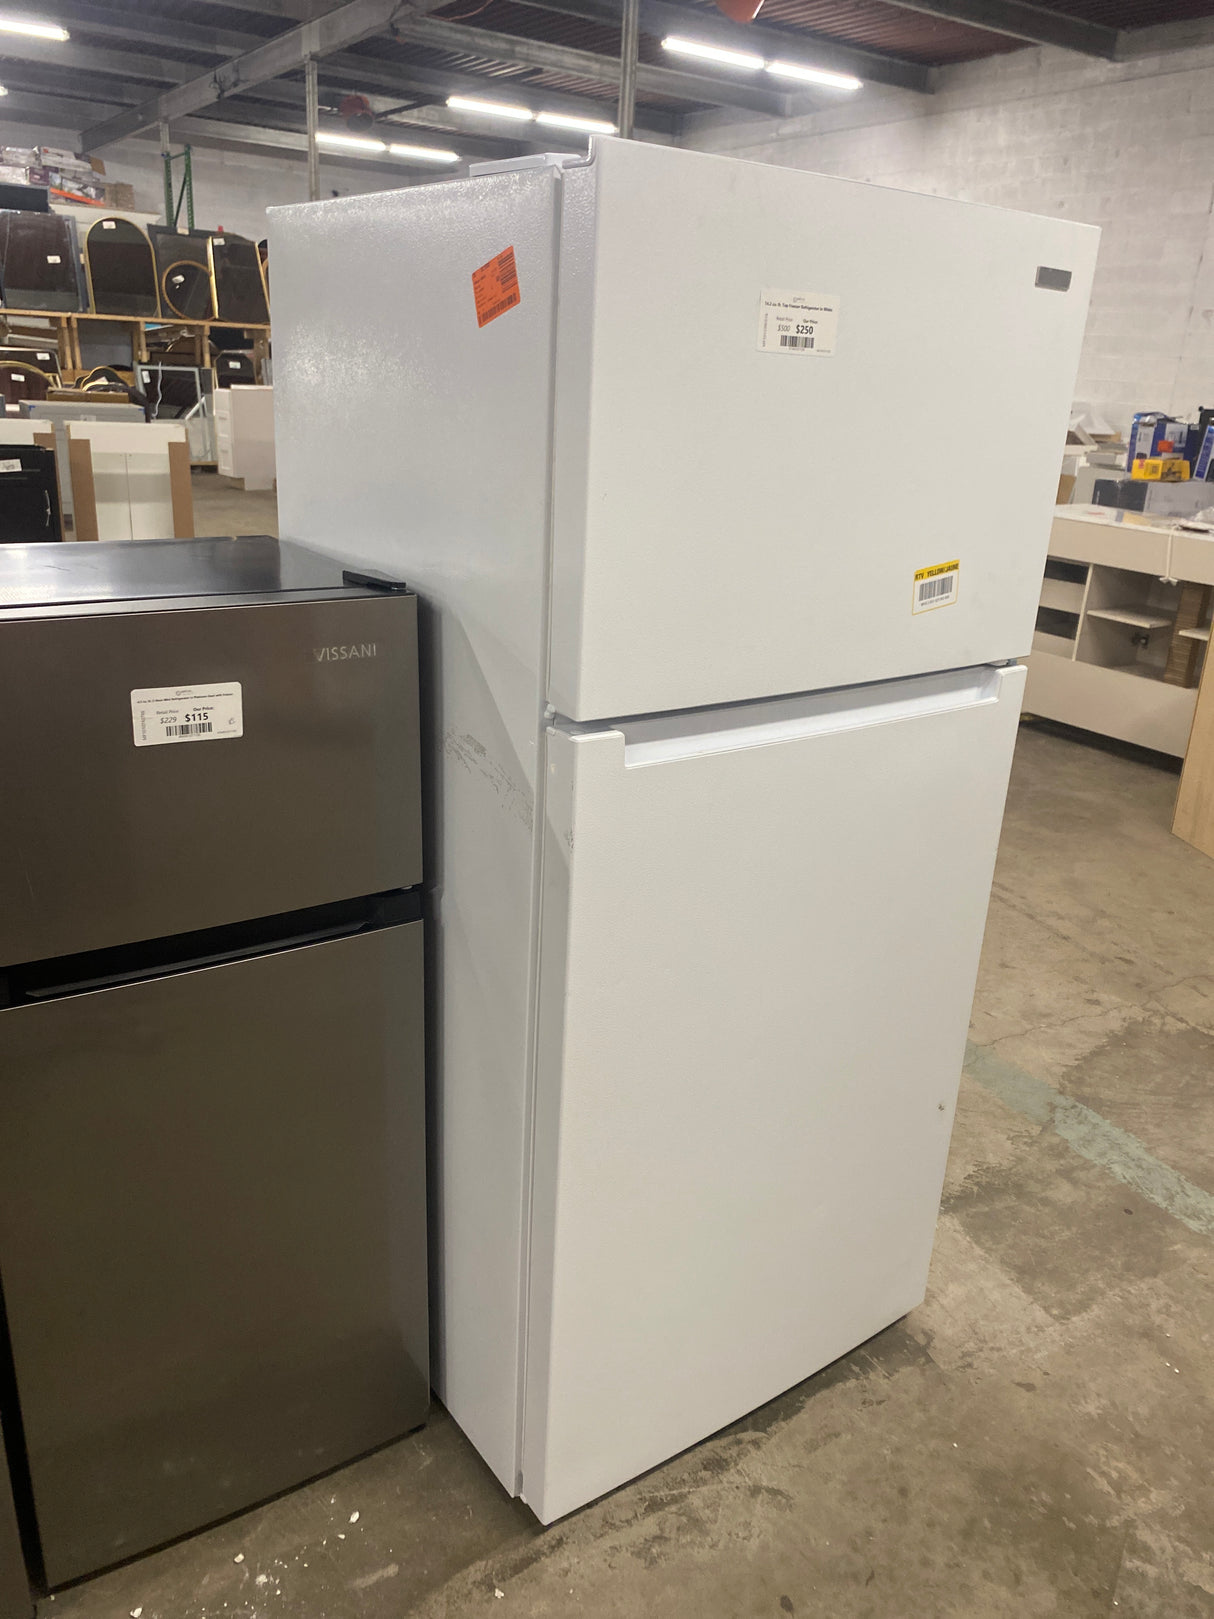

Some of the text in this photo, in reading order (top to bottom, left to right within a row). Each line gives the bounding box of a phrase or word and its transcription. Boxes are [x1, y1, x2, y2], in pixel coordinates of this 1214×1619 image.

[795, 324, 814, 335] $250
[313, 642, 376, 662] VISSANI
[160, 716, 177, 725] $229
[184, 712, 209, 723] $115
